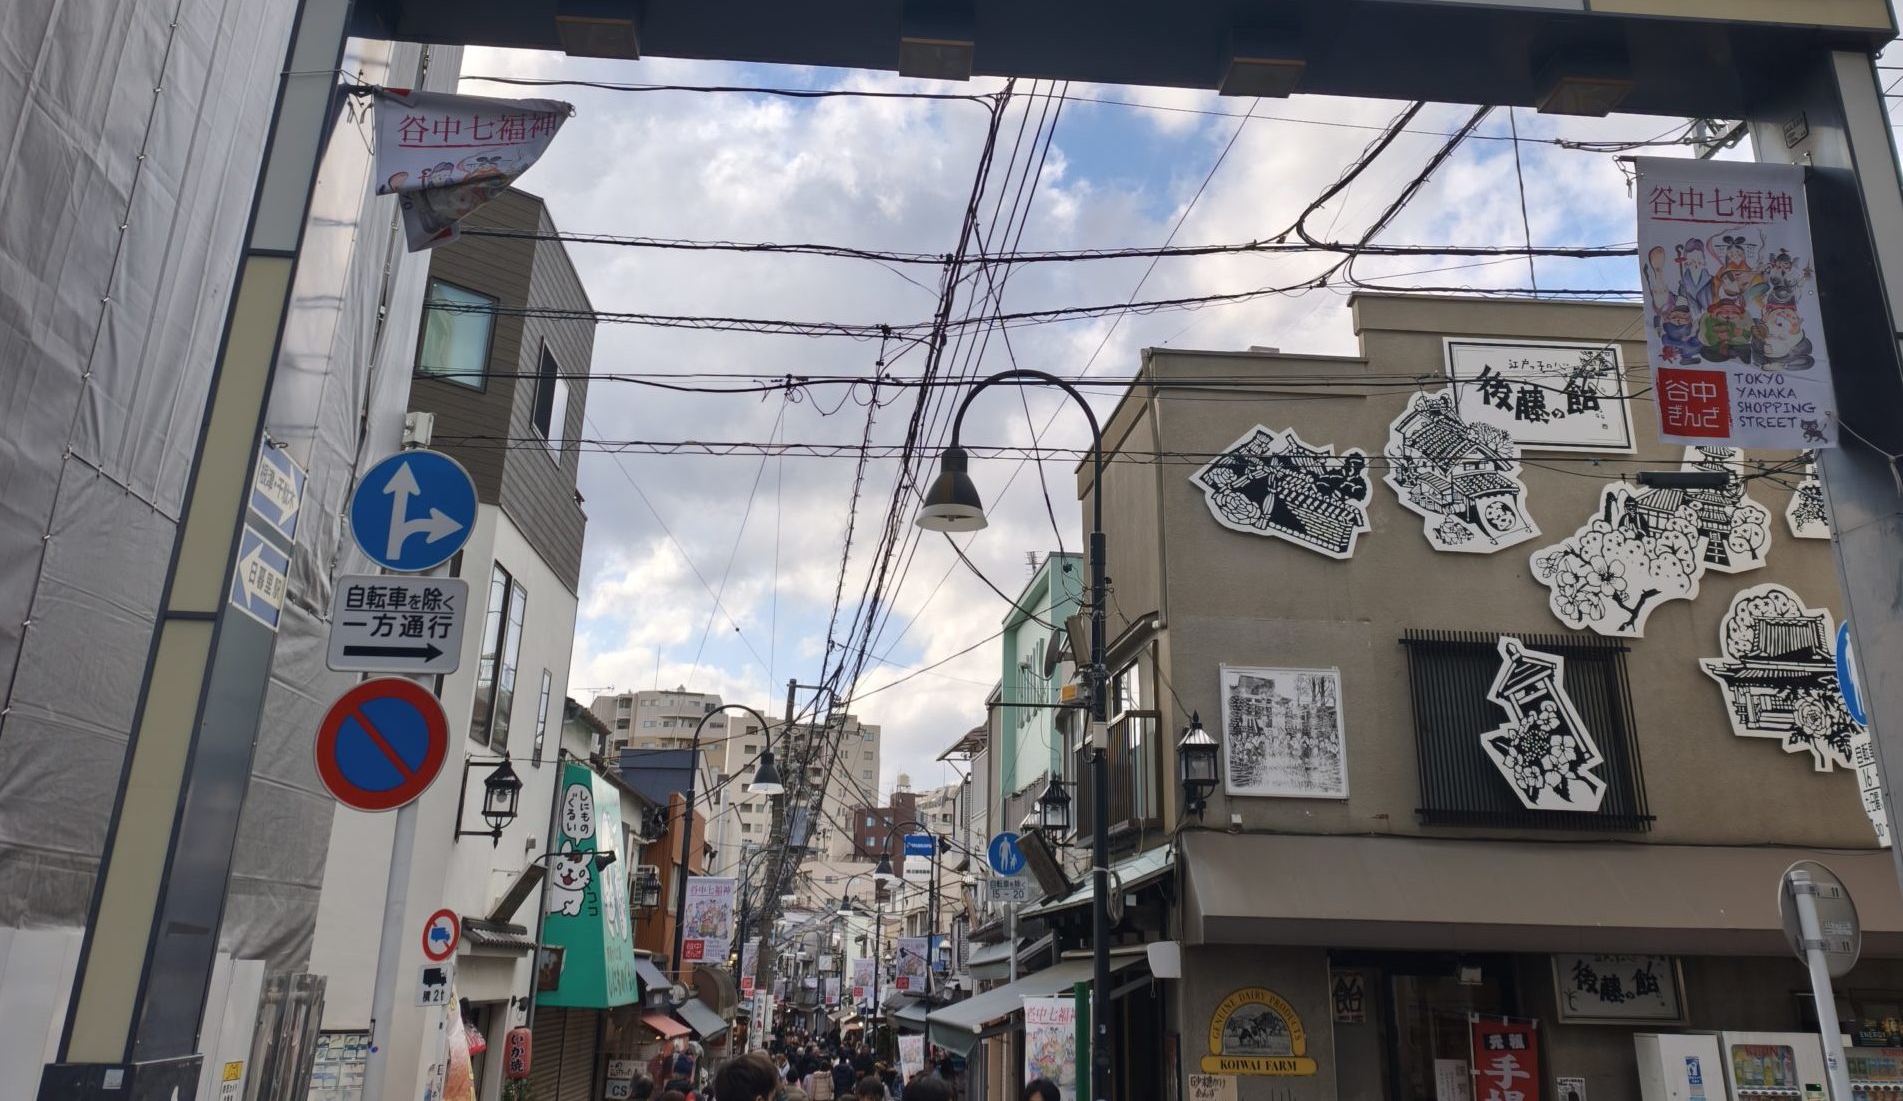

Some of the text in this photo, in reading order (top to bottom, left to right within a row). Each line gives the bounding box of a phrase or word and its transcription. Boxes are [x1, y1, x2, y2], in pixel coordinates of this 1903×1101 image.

[399, 113, 557, 144] 谷中七福神
[1649, 184, 1793, 221] 谷中七福神
[1665, 380, 1717, 403] 谷中
[1734, 372, 1785, 386] TOKYO
[1476, 364, 1600, 424] 後藤の飴
[1736, 386, 1798, 400] YANAKA
[1668, 405, 1720, 429] ぎんざ
[1738, 401, 1817, 415] SHOPPING
[1741, 416, 1798, 429] STREET
[346, 584, 455, 611] 自転車を除く
[342, 613, 453, 639] 一方通行
[566, 792, 578, 832] ぐるい
[580, 790, 590, 835] しにもの
[1220, 1059, 1297, 1072] KOIWAI FARM
